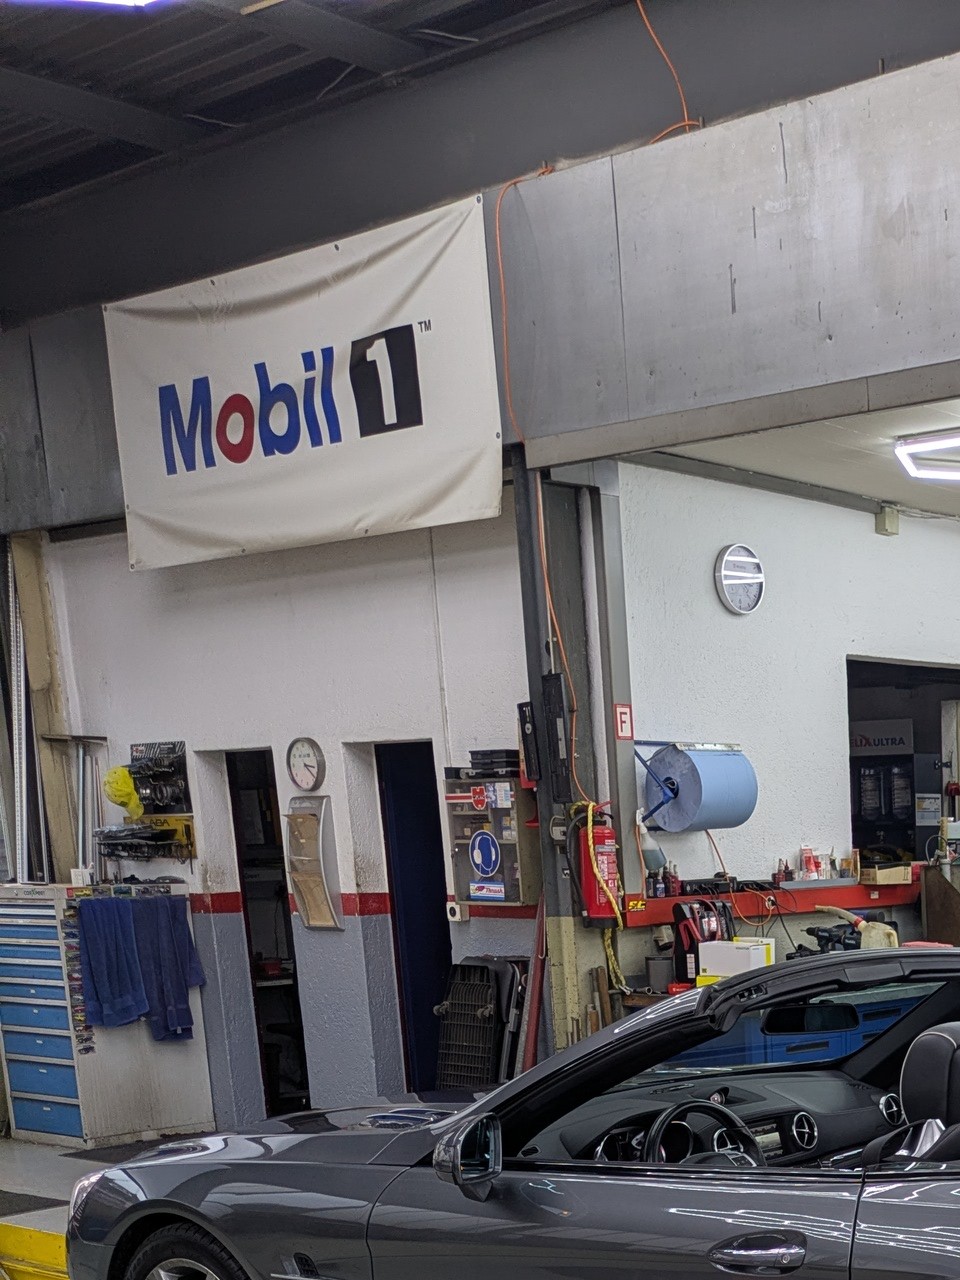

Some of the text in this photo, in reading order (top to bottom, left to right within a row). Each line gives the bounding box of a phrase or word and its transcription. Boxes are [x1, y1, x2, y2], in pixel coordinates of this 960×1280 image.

[158, 346, 342, 476] Mobil
[619, 711, 628, 733] F
[873, 737, 906, 747] ULTRA
